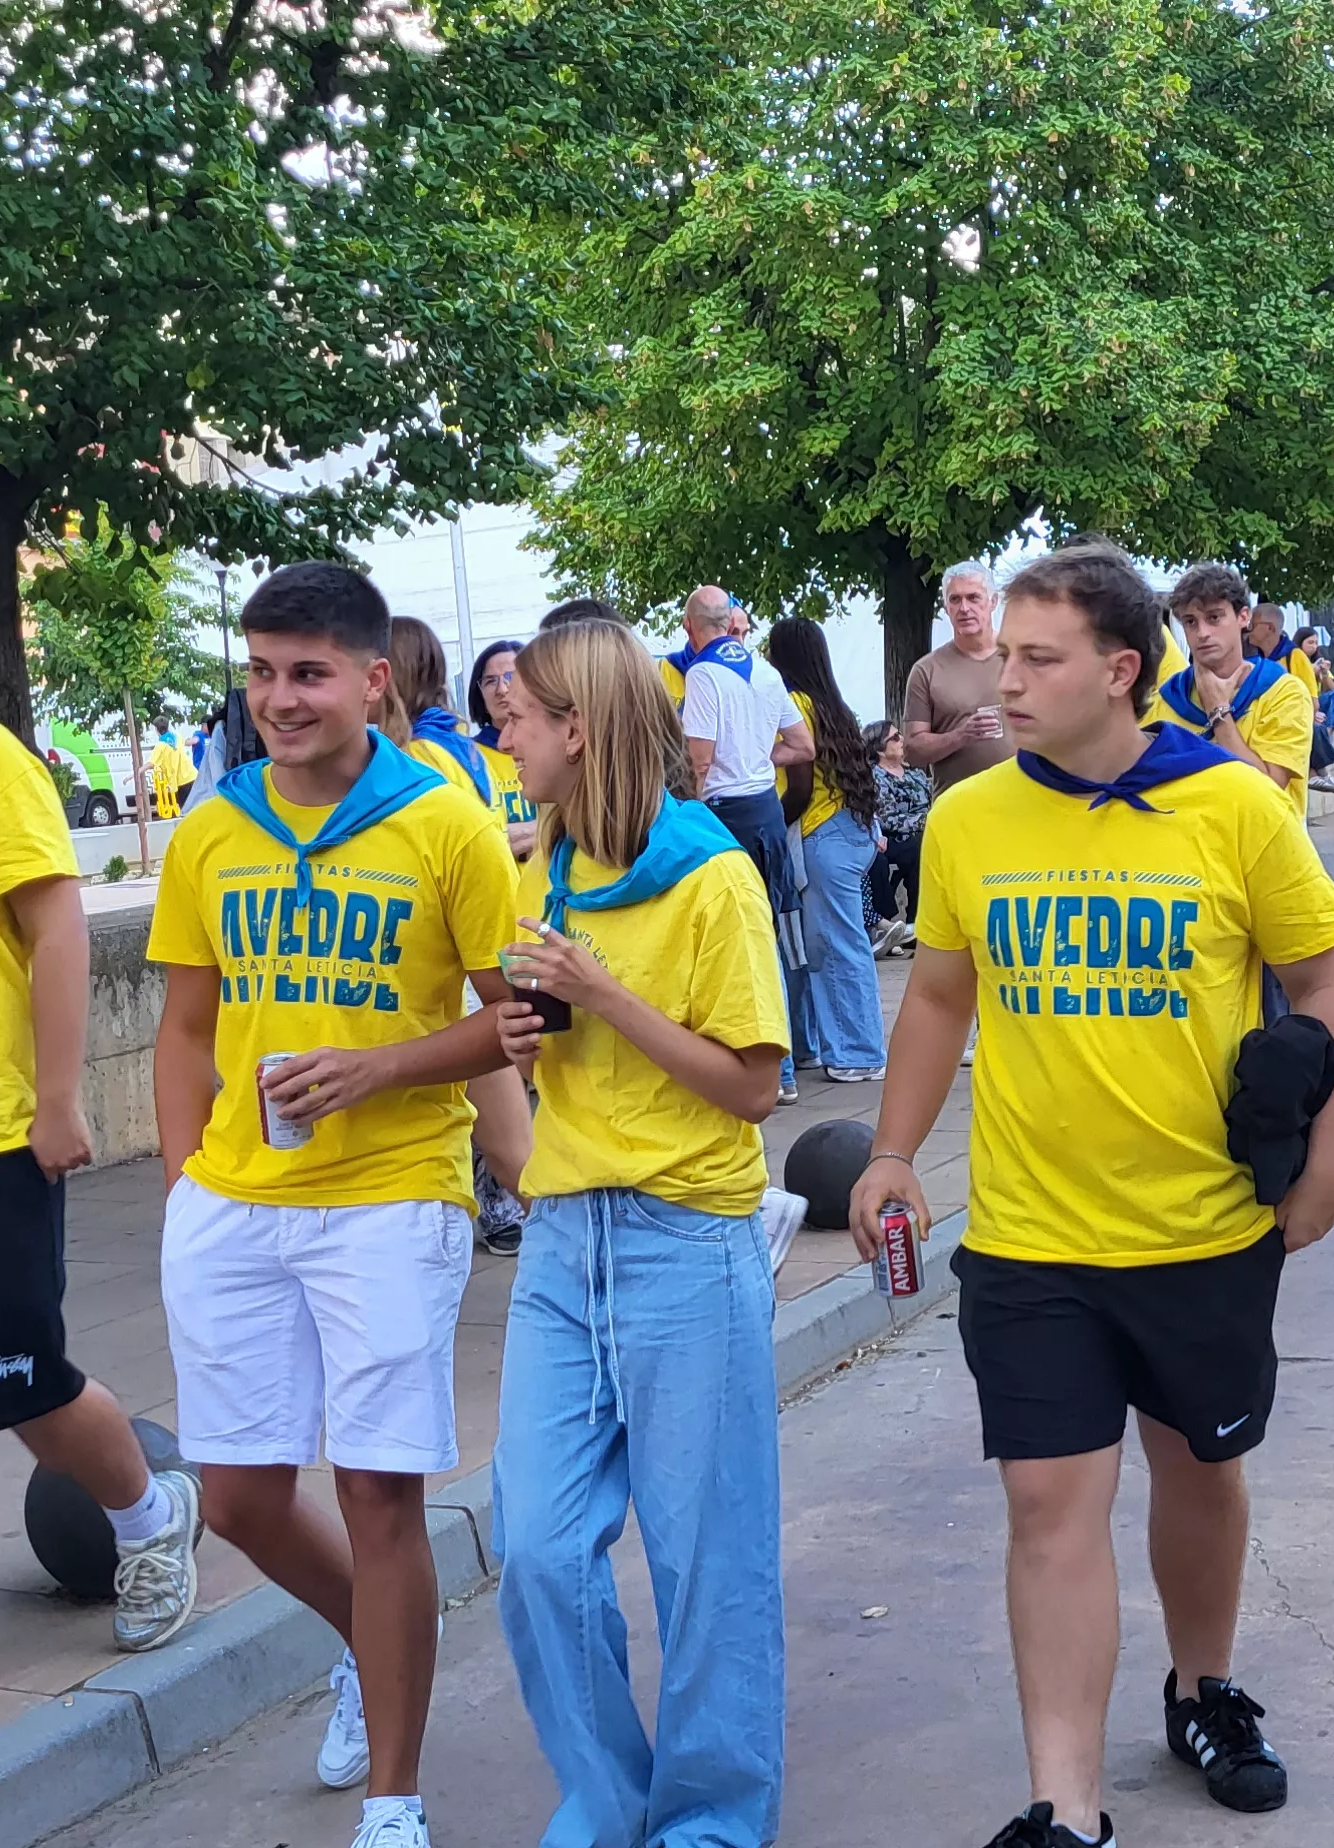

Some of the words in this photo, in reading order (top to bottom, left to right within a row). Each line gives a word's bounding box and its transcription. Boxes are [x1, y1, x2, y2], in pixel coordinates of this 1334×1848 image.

[275, 863, 351, 877] FITAS
[1047, 870, 1129, 882] FIESTAS
[238, 959, 293, 973] SANTA
[307, 961, 377, 979] LETICIA
[1010, 970, 1071, 983] SANTA
[1086, 971, 1169, 985] LETICIA
[888, 1224, 911, 1291] AMBAR
